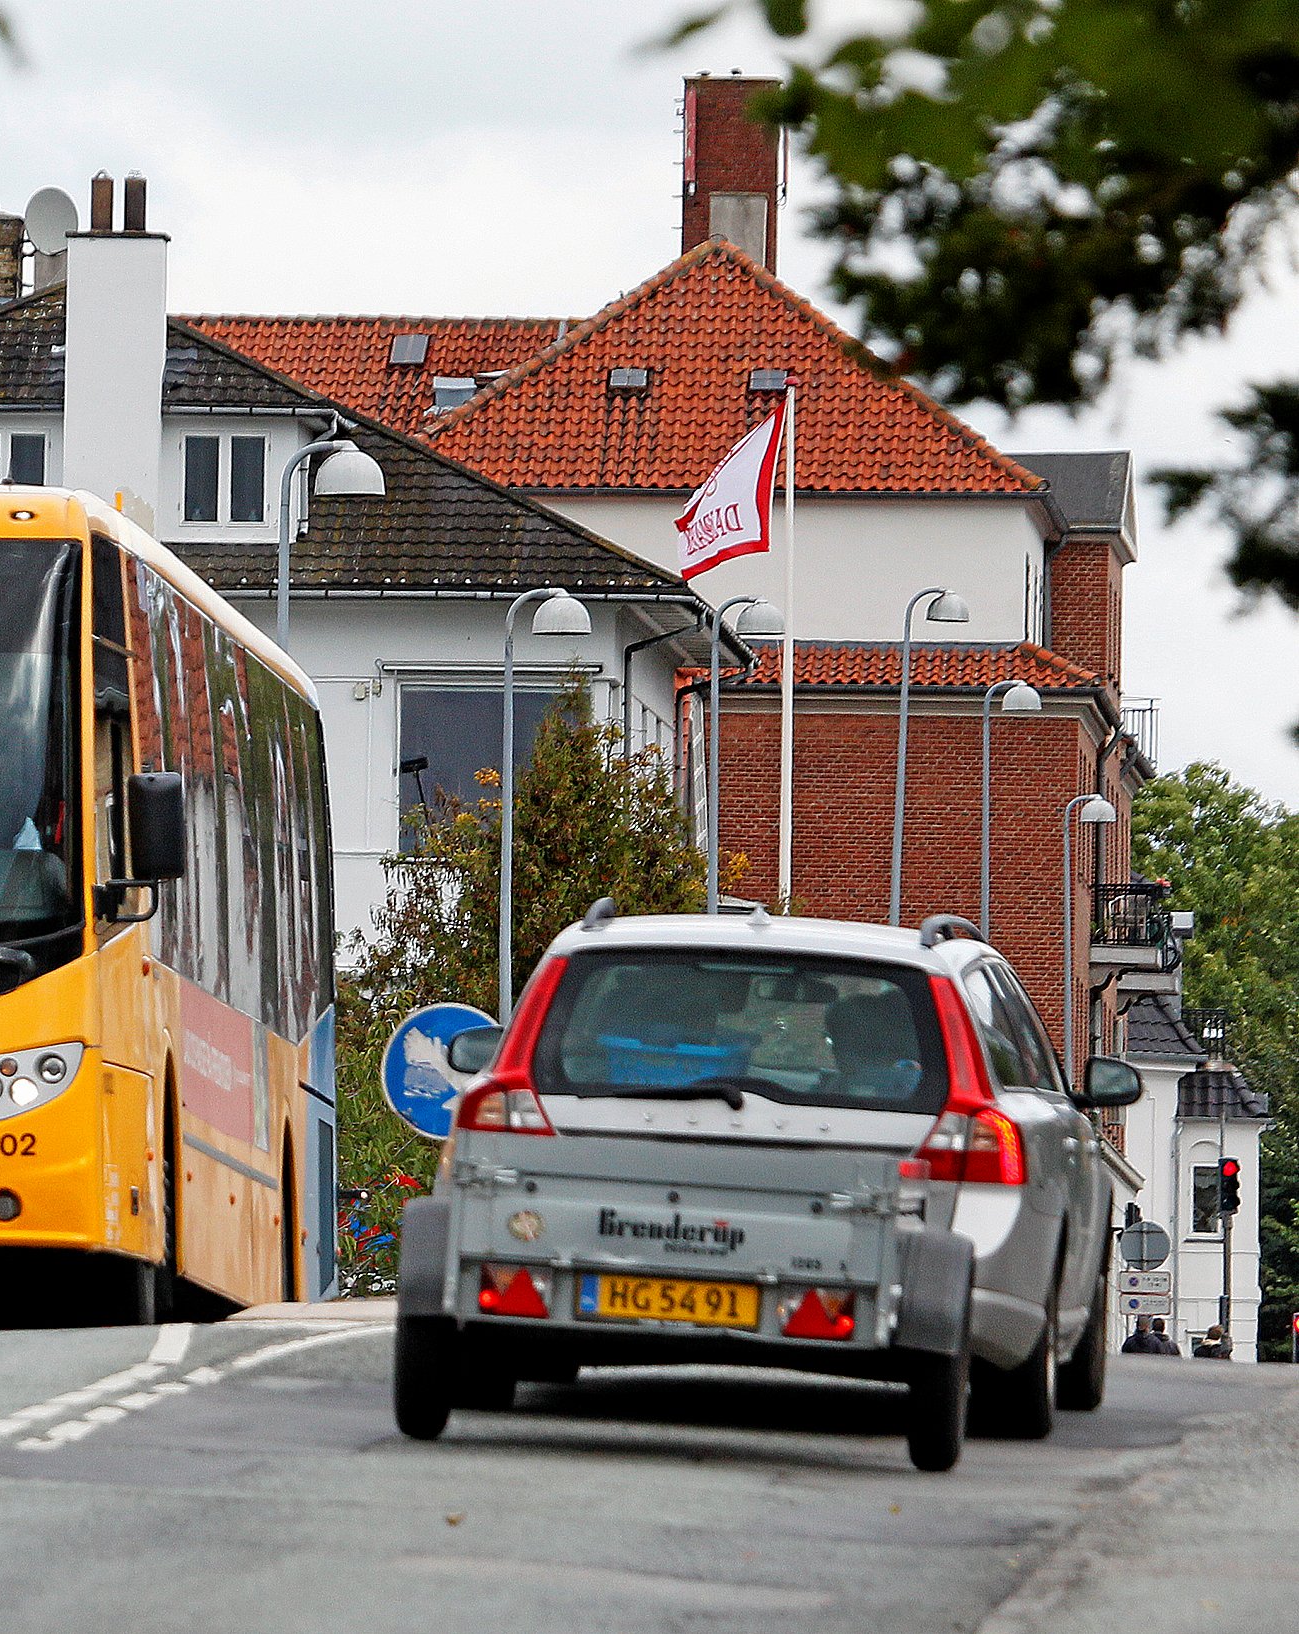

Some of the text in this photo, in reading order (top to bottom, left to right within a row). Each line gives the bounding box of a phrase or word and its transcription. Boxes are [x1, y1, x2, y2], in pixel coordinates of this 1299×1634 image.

[609, 1279, 740, 1318] HG 54 91
